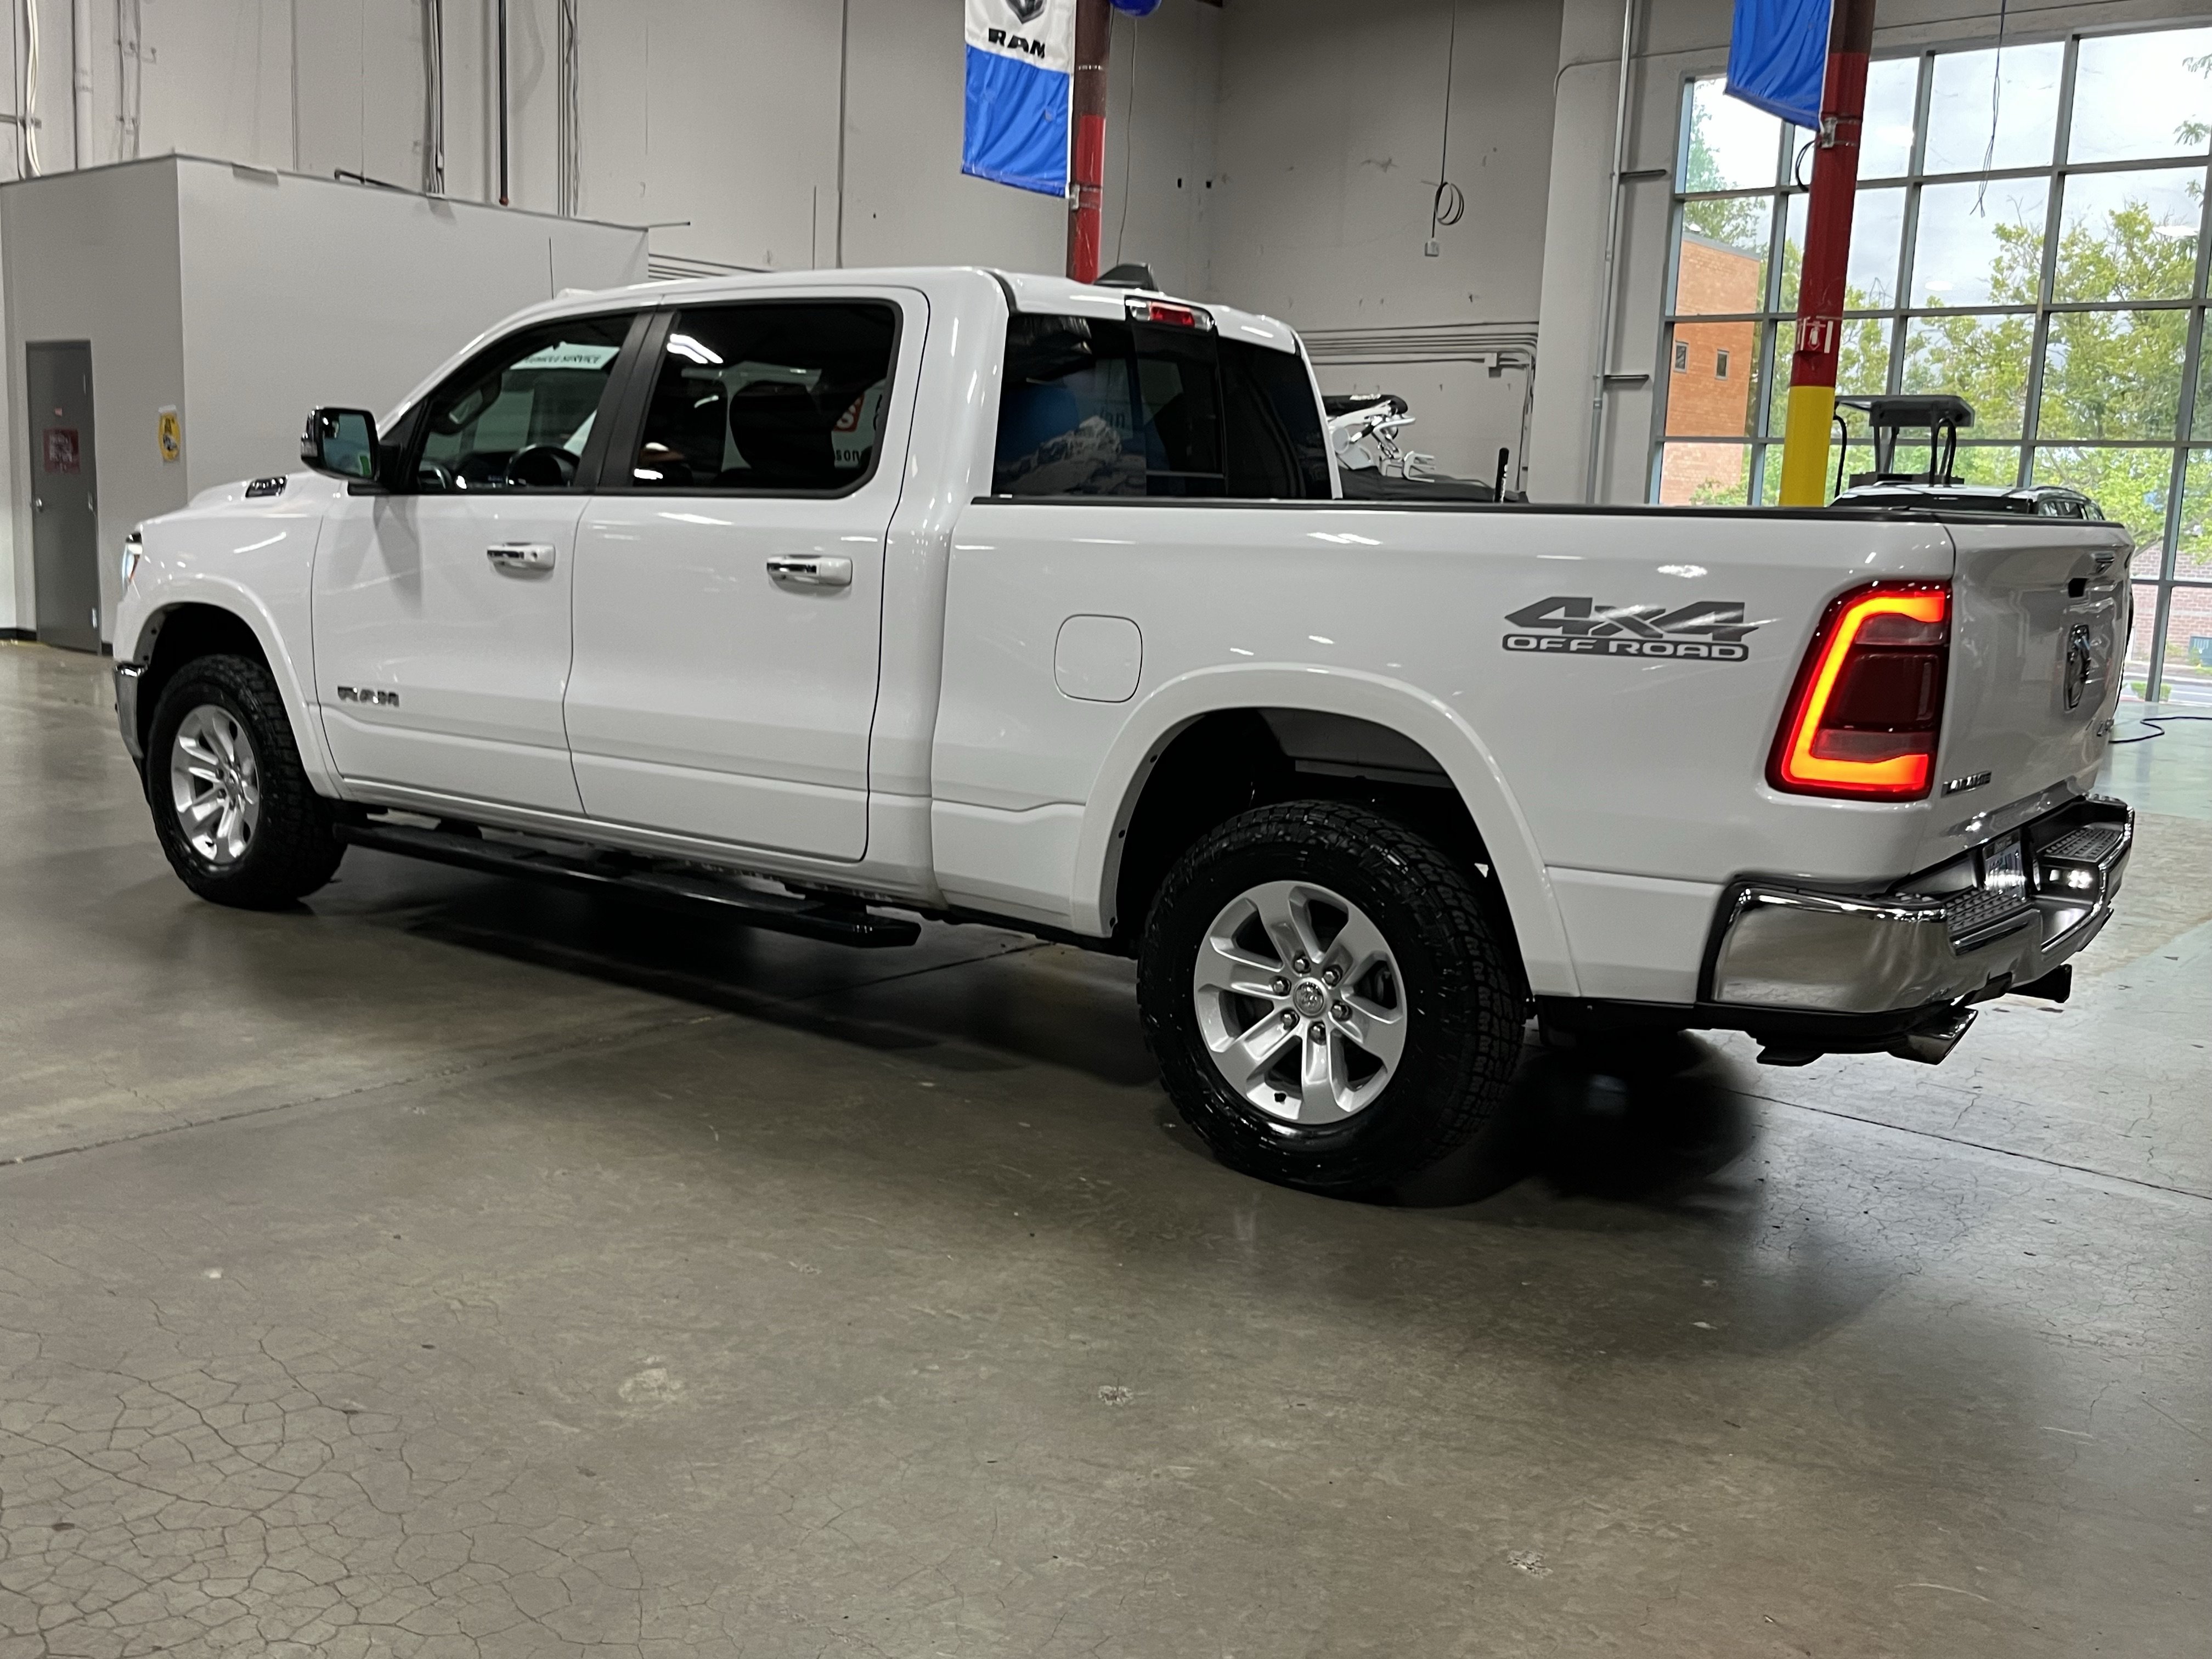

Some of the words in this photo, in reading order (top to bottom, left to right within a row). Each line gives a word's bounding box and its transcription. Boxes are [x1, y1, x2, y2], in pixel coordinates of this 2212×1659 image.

[988, 27, 1045, 59] RAM
[1504, 596, 1759, 642] 4x4
[1506, 636, 1598, 652] OFF
[1608, 640, 1743, 659] ROAD
[337, 686, 399, 708] RAM
